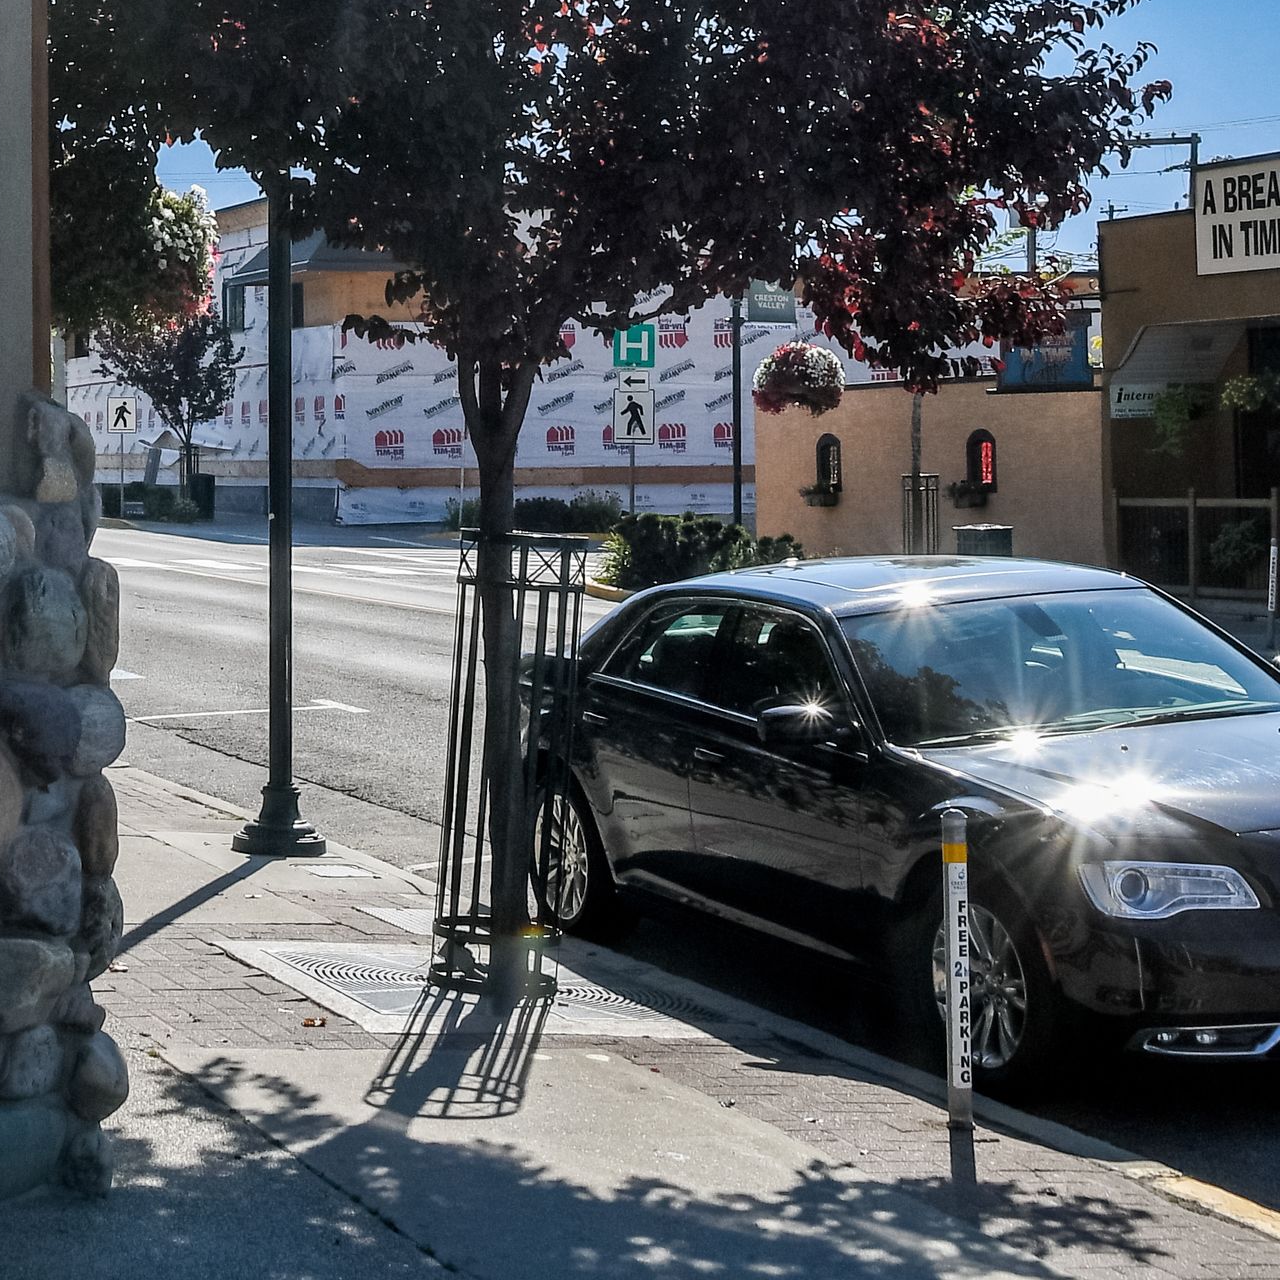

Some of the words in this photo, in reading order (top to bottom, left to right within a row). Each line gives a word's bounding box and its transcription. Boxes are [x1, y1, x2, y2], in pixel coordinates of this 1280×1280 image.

[1203, 180, 1216, 215] A
[1223, 171, 1280, 213] BREA
[1212, 224, 1233, 259] IN
[1240, 219, 1280, 256] TIM
[754, 294, 788, 302] CRESTON
[620, 331, 648, 361] H
[365, 395, 404, 417] NovaWrap
[537, 391, 575, 413] NovaWrap
[655, 390, 686, 409] ovaWrap
[958, 900, 967, 957] FREE
[959, 981, 970, 1083] PARKING
